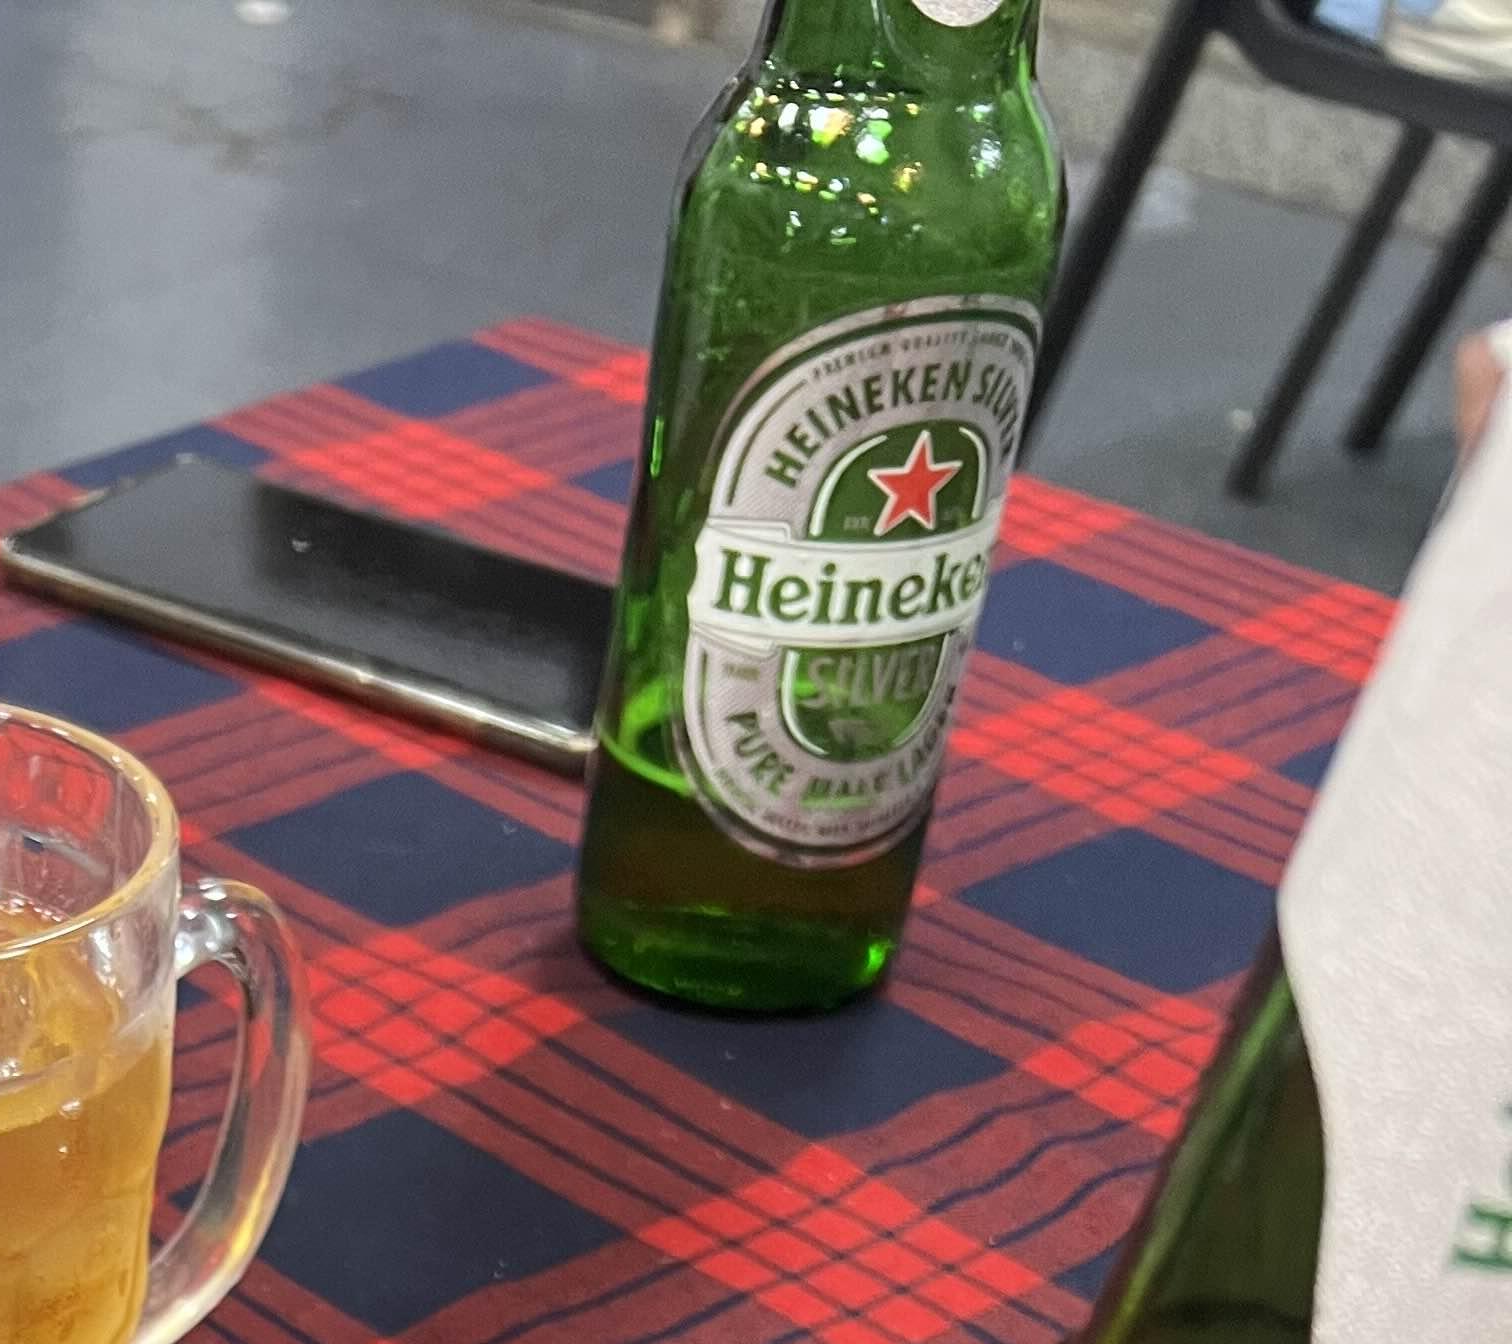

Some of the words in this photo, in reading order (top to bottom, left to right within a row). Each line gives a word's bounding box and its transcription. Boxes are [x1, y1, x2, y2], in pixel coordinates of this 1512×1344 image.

[764, 358, 973, 488] HEINEKEN
[712, 548, 987, 624] Heineke
[807, 645, 934, 709] SILVER
